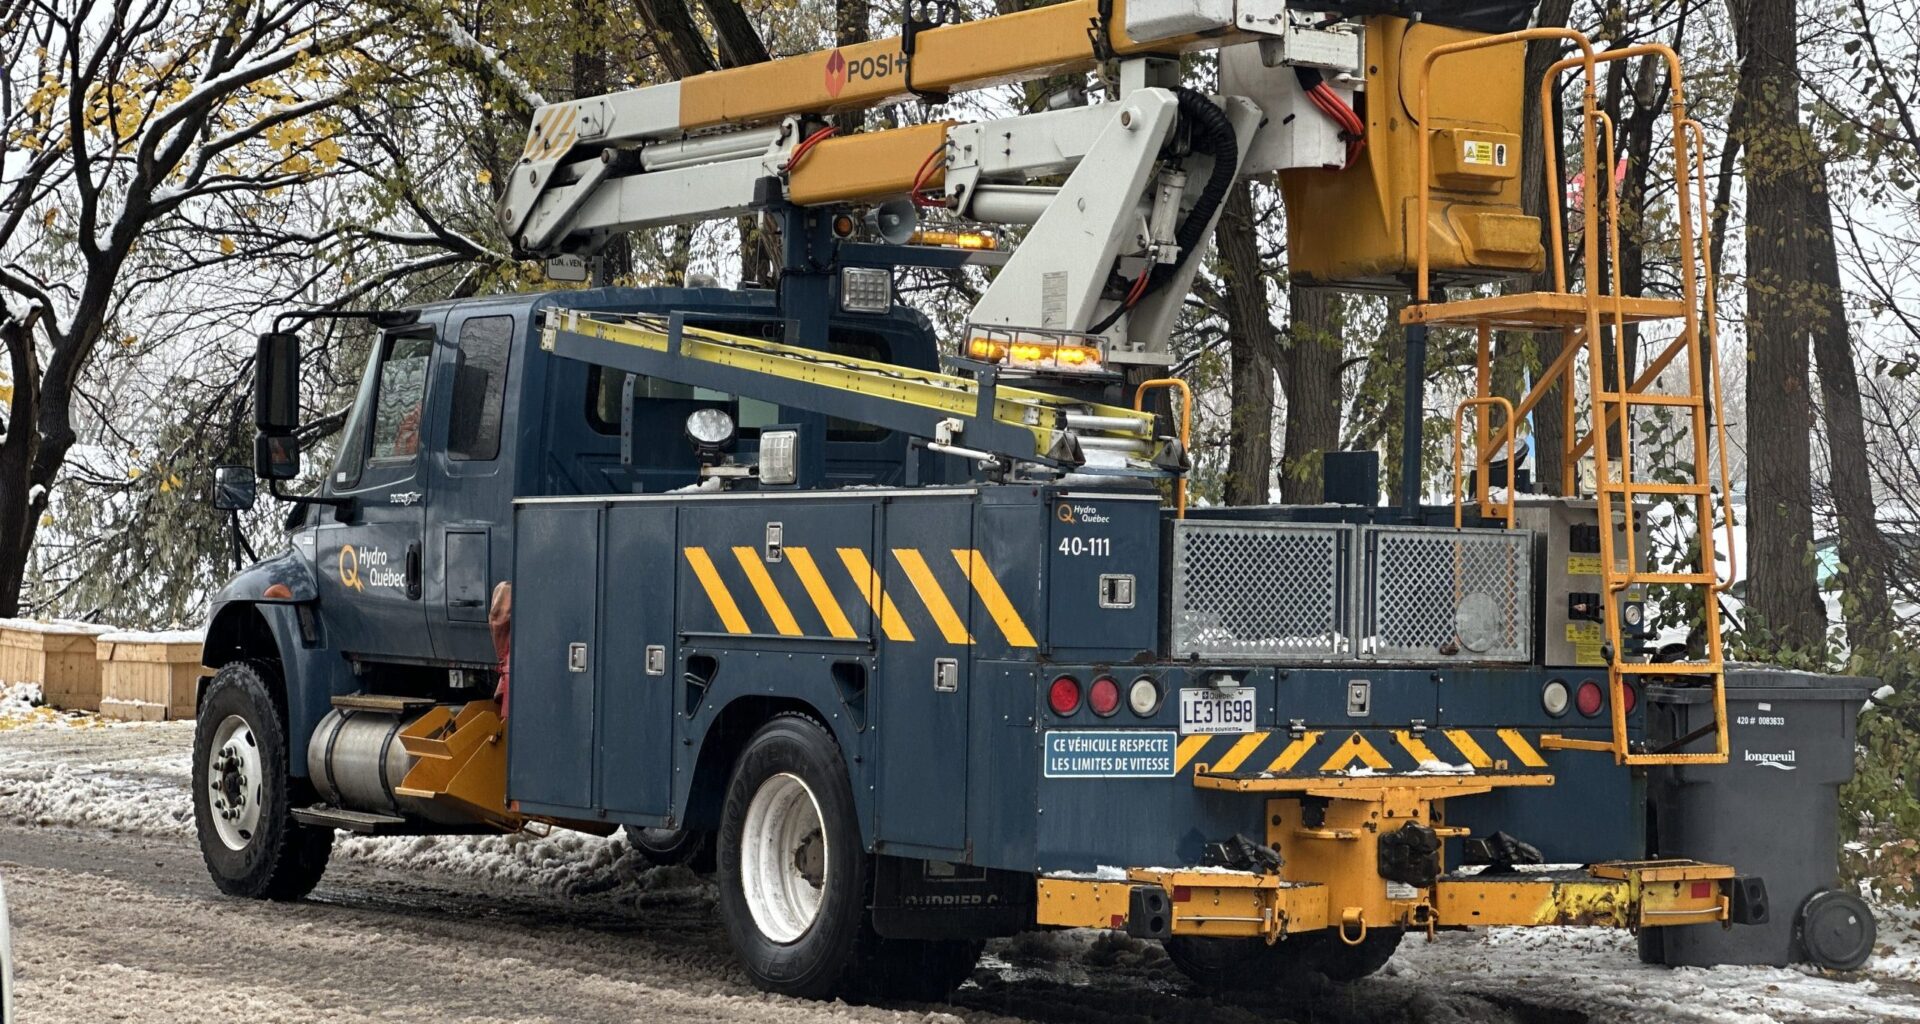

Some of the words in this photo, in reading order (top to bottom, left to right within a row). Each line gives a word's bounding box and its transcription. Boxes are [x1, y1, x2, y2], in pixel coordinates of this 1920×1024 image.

[1073, 505, 1097, 515] Hydro
[1081, 513, 1110, 523] Québec
[1058, 536, 1110, 556] 40-111
[359, 546, 388, 568] Hydro
[369, 567, 406, 587] Québec
[1183, 699, 1253, 724] LE31698
[1736, 715, 1749, 725] 420
[1053, 738, 1066, 752] CE
[1068, 736, 1117, 752] VÉHICULE
[1119, 738, 1169, 752] RESPECTE
[1051, 757, 1070, 771] LES
[1072, 757, 1113, 771] LIMITES
[1115, 757, 1128, 771] DE
[1130, 757, 1170, 771] VITESSE
[1744, 749, 1796, 766] longueuil
